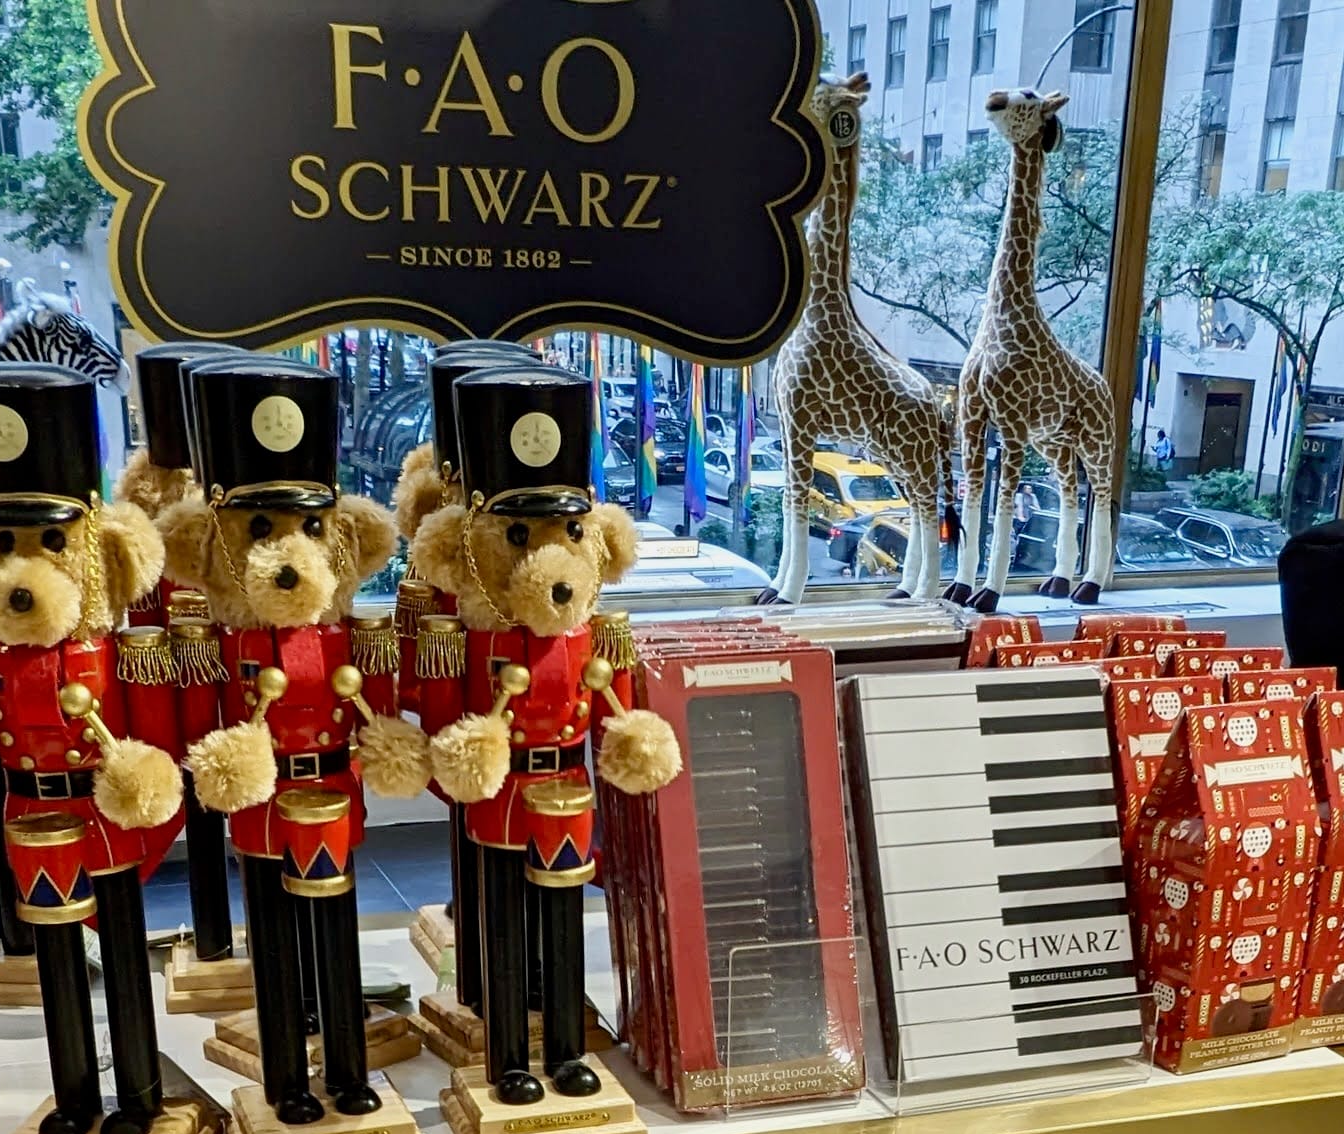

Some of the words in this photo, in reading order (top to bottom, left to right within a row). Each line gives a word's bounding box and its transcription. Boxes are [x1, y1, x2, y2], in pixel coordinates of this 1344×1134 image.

[400, 247, 493, 269] SINCE
[502, 248, 563, 270] 1862
[978, 929, 1121, 963] SCHWARZ
[1020, 976, 1029, 984] 30
[1031, 970, 1083, 983] ROCKEFELLER
[1084, 968, 1108, 977] PLAZA
[1312, 1016, 1335, 1027] MILK
[1300, 1026, 1335, 1036] PEANUT
[1201, 1037, 1226, 1049] MILK
[1227, 1030, 1280, 1045] CHOCOLATE
[1190, 1046, 1228, 1058] PEANUT
[694, 1075, 733, 1088] SOLID
[737, 1073, 770, 1084] MILK
